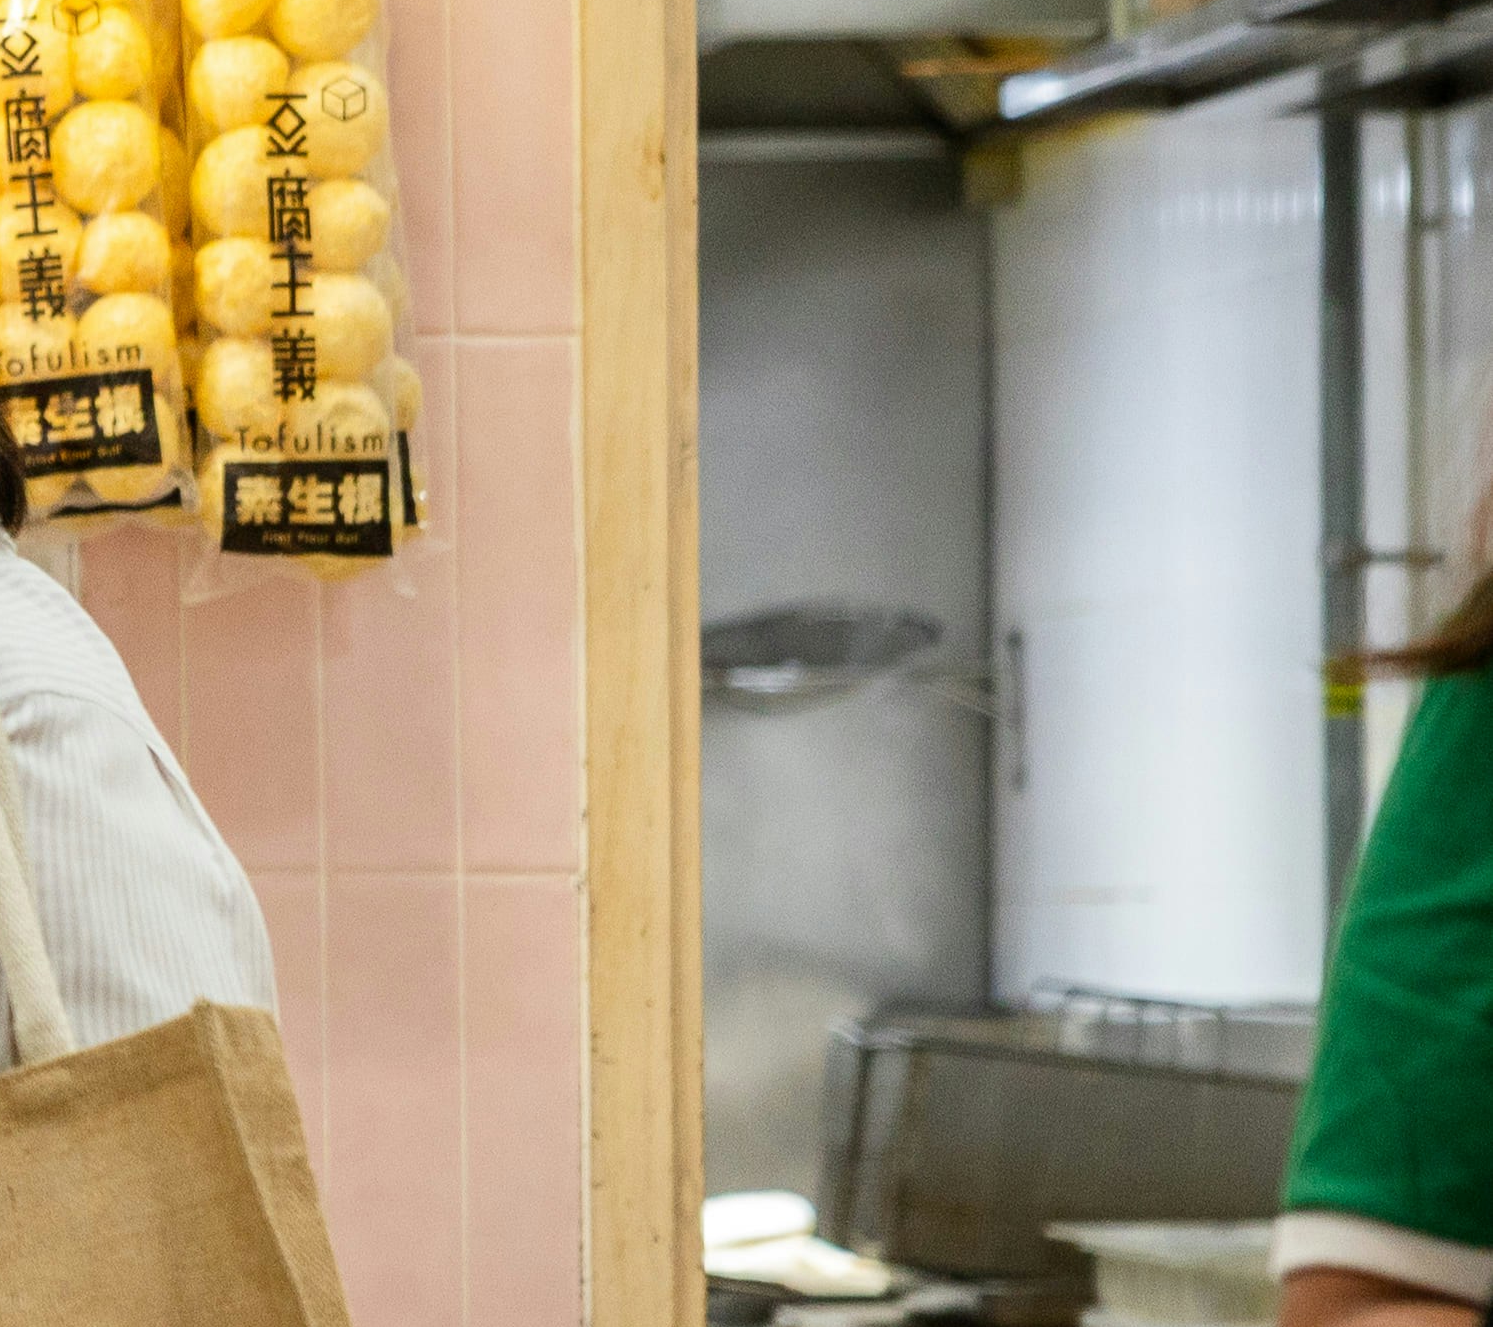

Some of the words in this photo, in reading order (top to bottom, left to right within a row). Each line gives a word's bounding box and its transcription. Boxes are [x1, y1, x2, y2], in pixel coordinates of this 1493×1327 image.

[265, 92, 317, 403] 豆腐主義
[235, 421, 385, 454] Tofulism
[235, 472, 384, 526] 素生根
